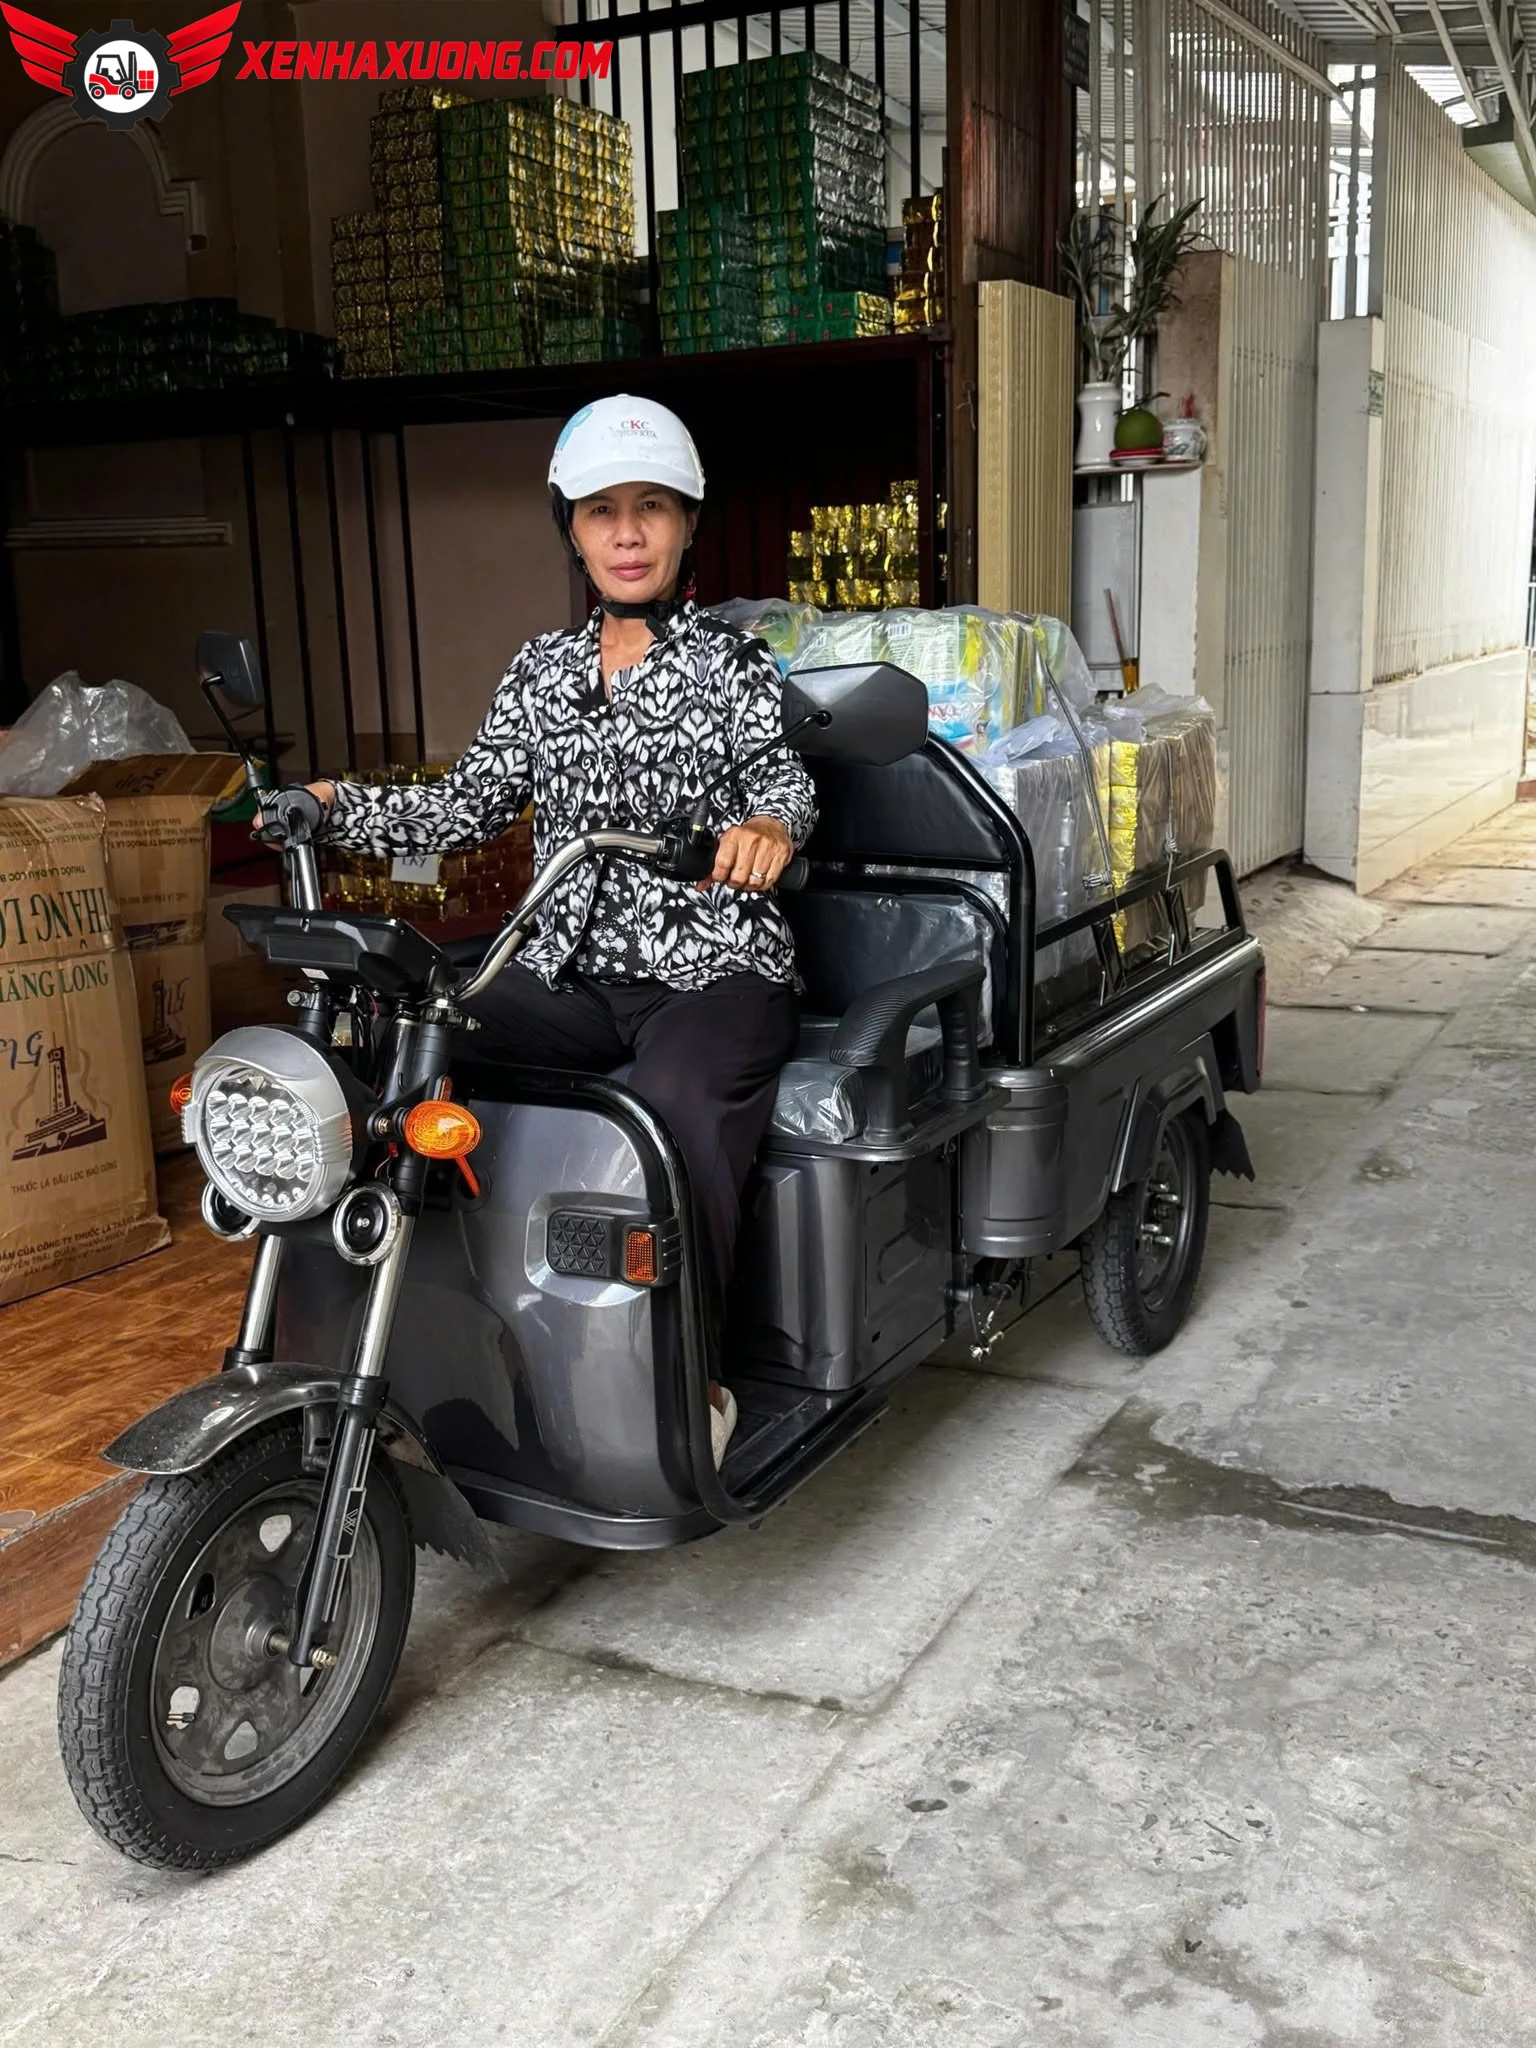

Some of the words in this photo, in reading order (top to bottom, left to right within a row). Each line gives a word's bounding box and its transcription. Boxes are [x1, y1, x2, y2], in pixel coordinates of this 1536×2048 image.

[621, 419, 650, 430] CKC
[0, 969, 56, 1002] ĂNG
[57, 960, 109, 994] LONG
